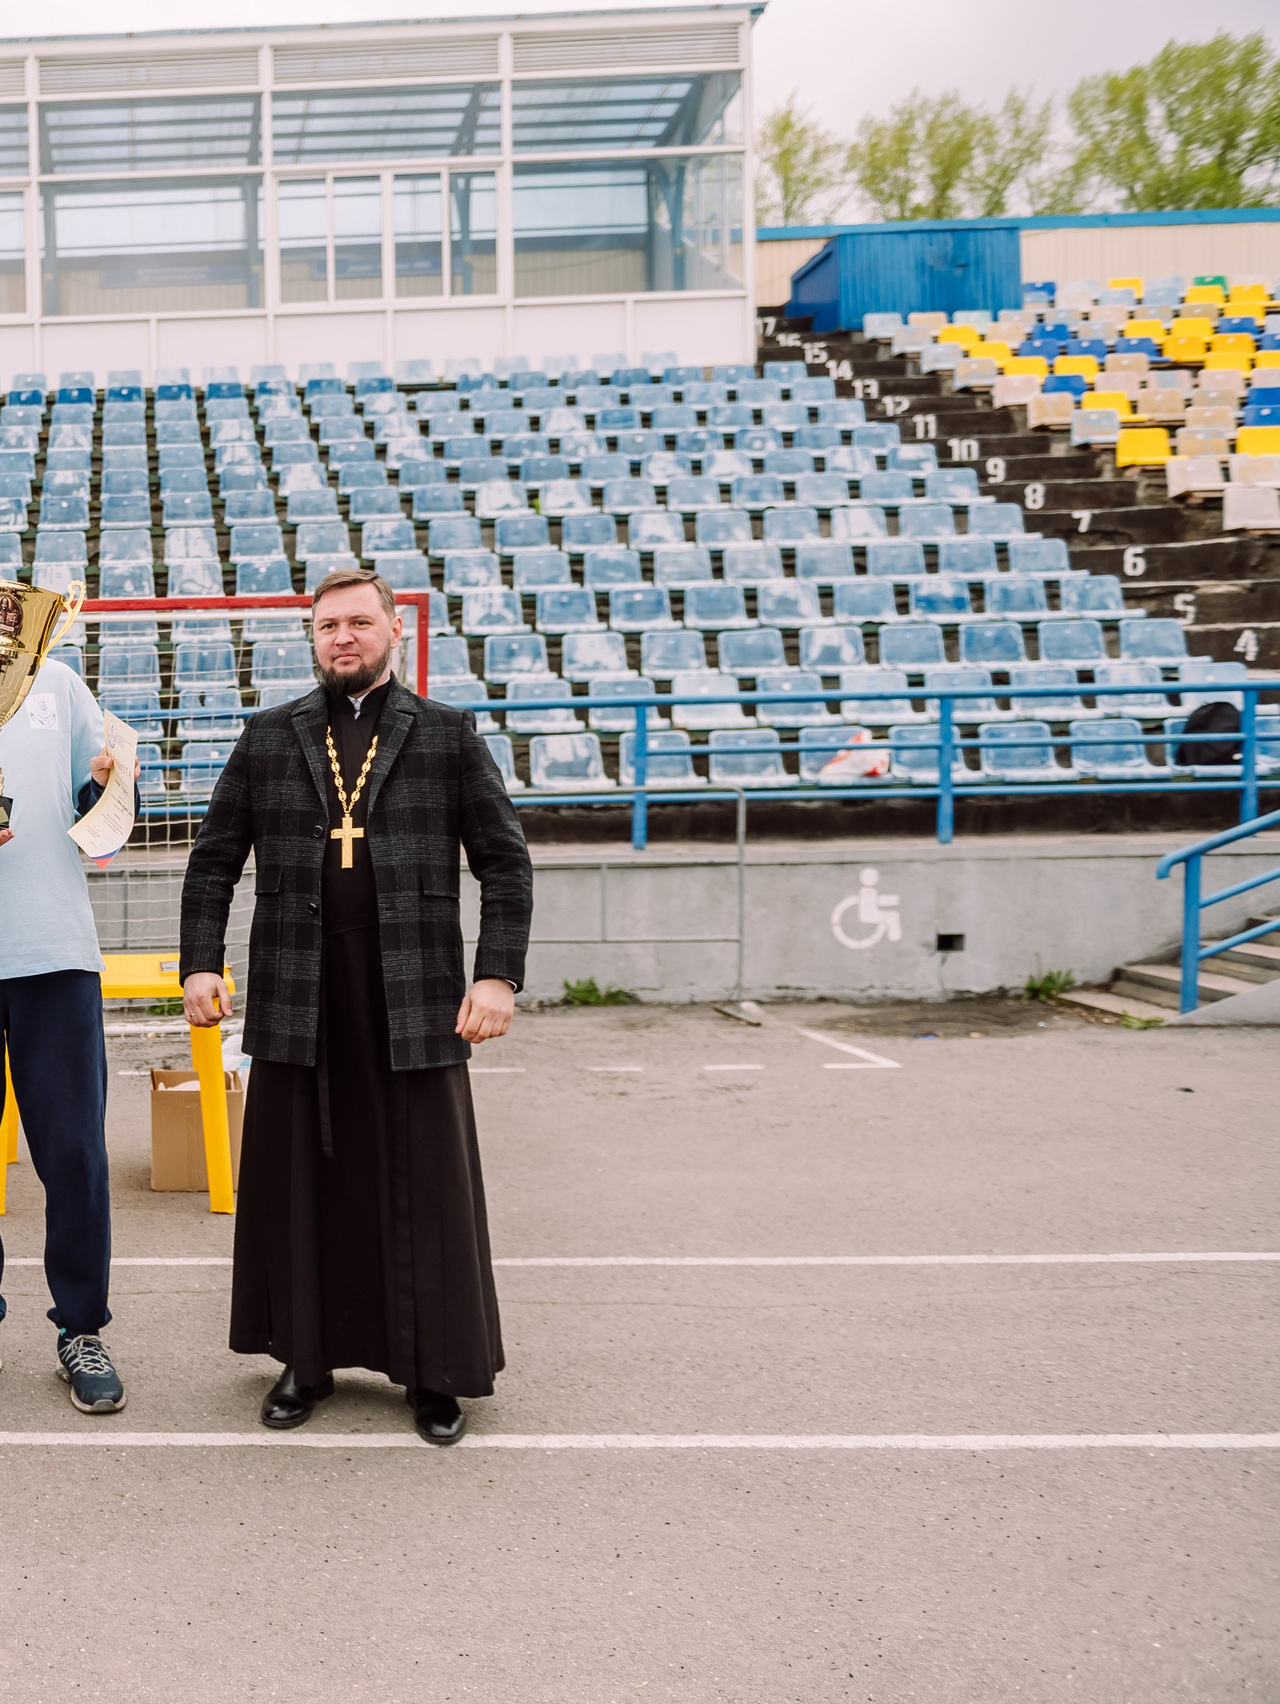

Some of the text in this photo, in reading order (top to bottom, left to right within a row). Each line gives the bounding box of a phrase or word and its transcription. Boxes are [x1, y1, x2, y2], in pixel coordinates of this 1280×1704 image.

[775, 332, 802, 347] 16
[801, 341, 828, 364] 15
[825, 359, 853, 380] 14
[851, 378, 879, 399] 13
[880, 395, 910, 417] 12
[911, 413, 937, 439] 11
[946, 437, 979, 462] 10
[985, 457, 1006, 484] 9
[1023, 481, 1045, 510] 8
[1070, 510, 1092, 533] 7
[1122, 546, 1147, 577] 6
[1173, 592, 1197, 626] 5
[1232, 629, 1260, 662] 4
